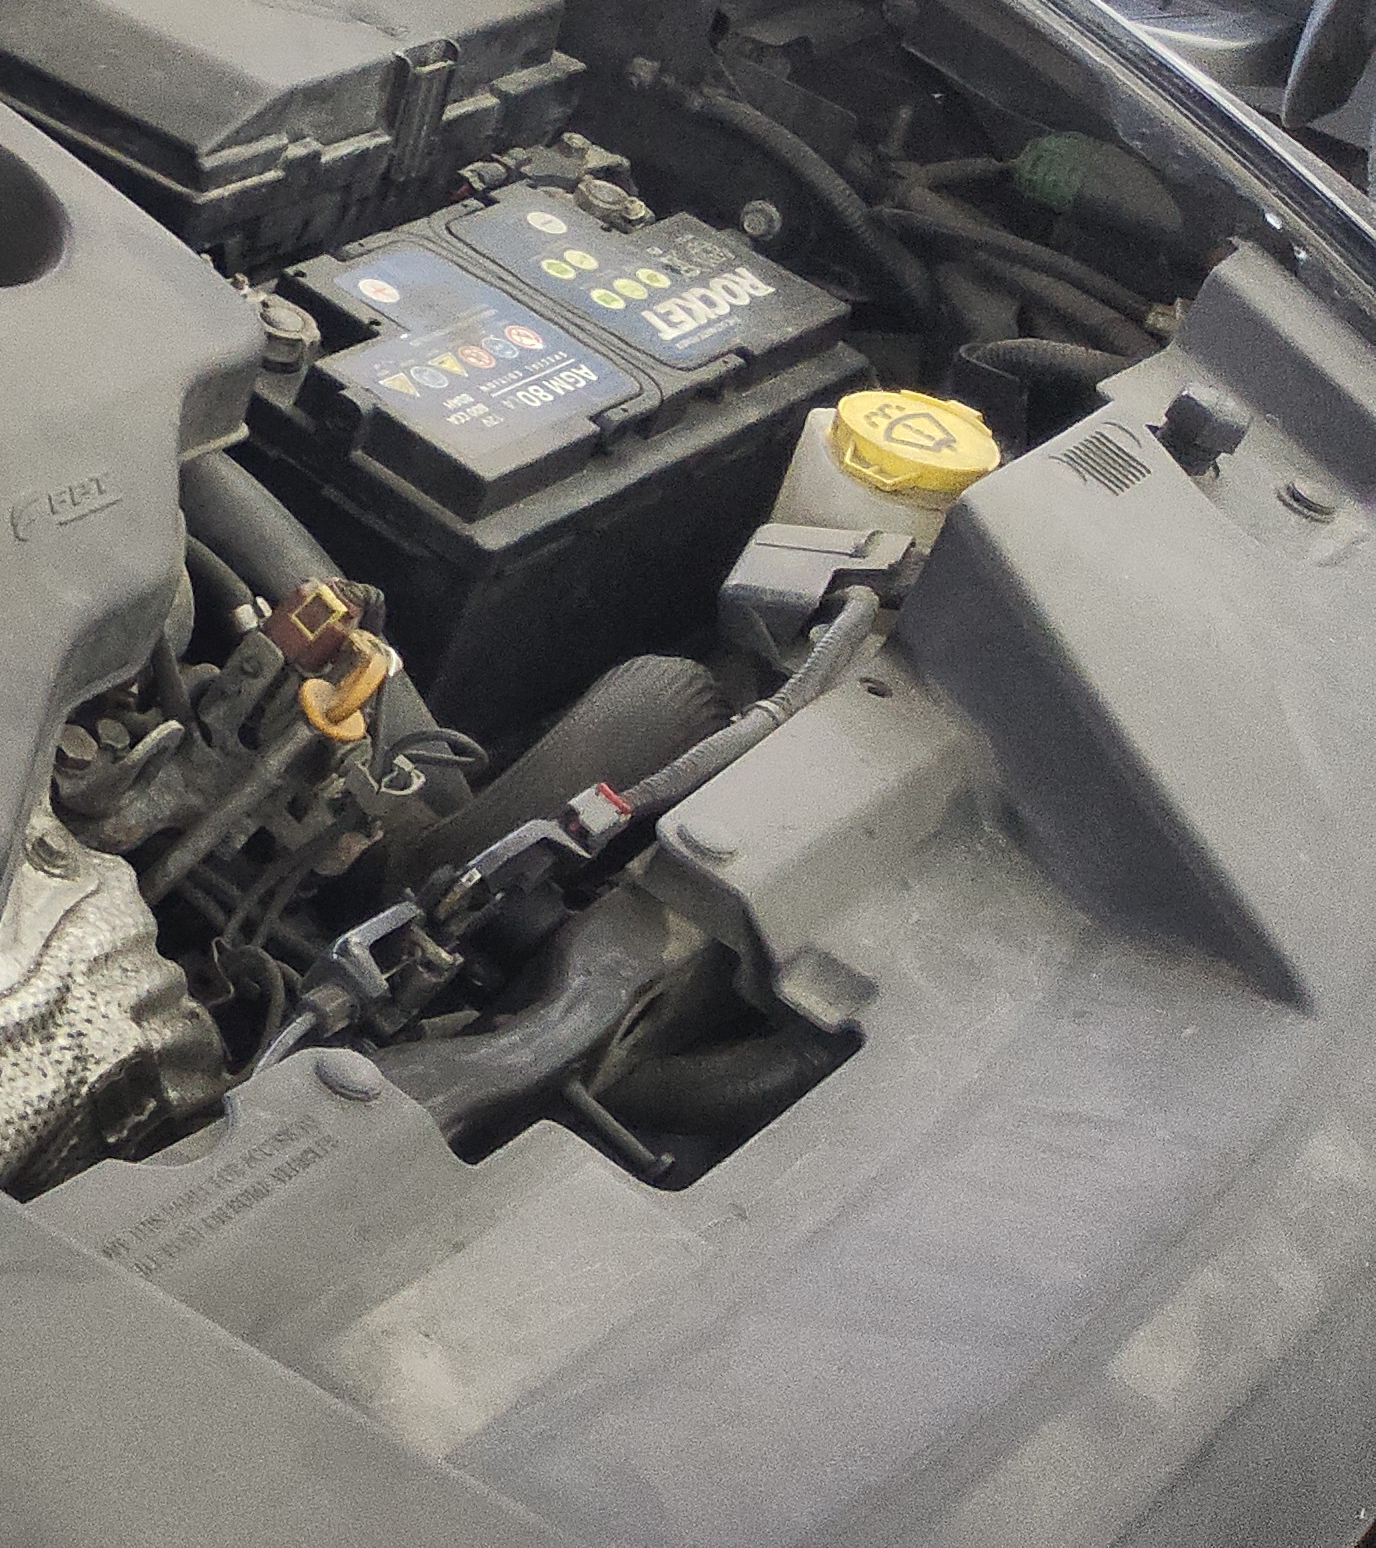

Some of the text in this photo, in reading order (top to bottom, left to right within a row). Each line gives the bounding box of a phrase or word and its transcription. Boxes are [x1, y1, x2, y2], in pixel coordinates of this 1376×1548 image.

[640, 266, 776, 341] ROCKET
[541, 363, 599, 396] AGM
[515, 384, 555, 408] 80
[446, 411, 471, 426] CCA
[480, 412, 505, 428] 12V
